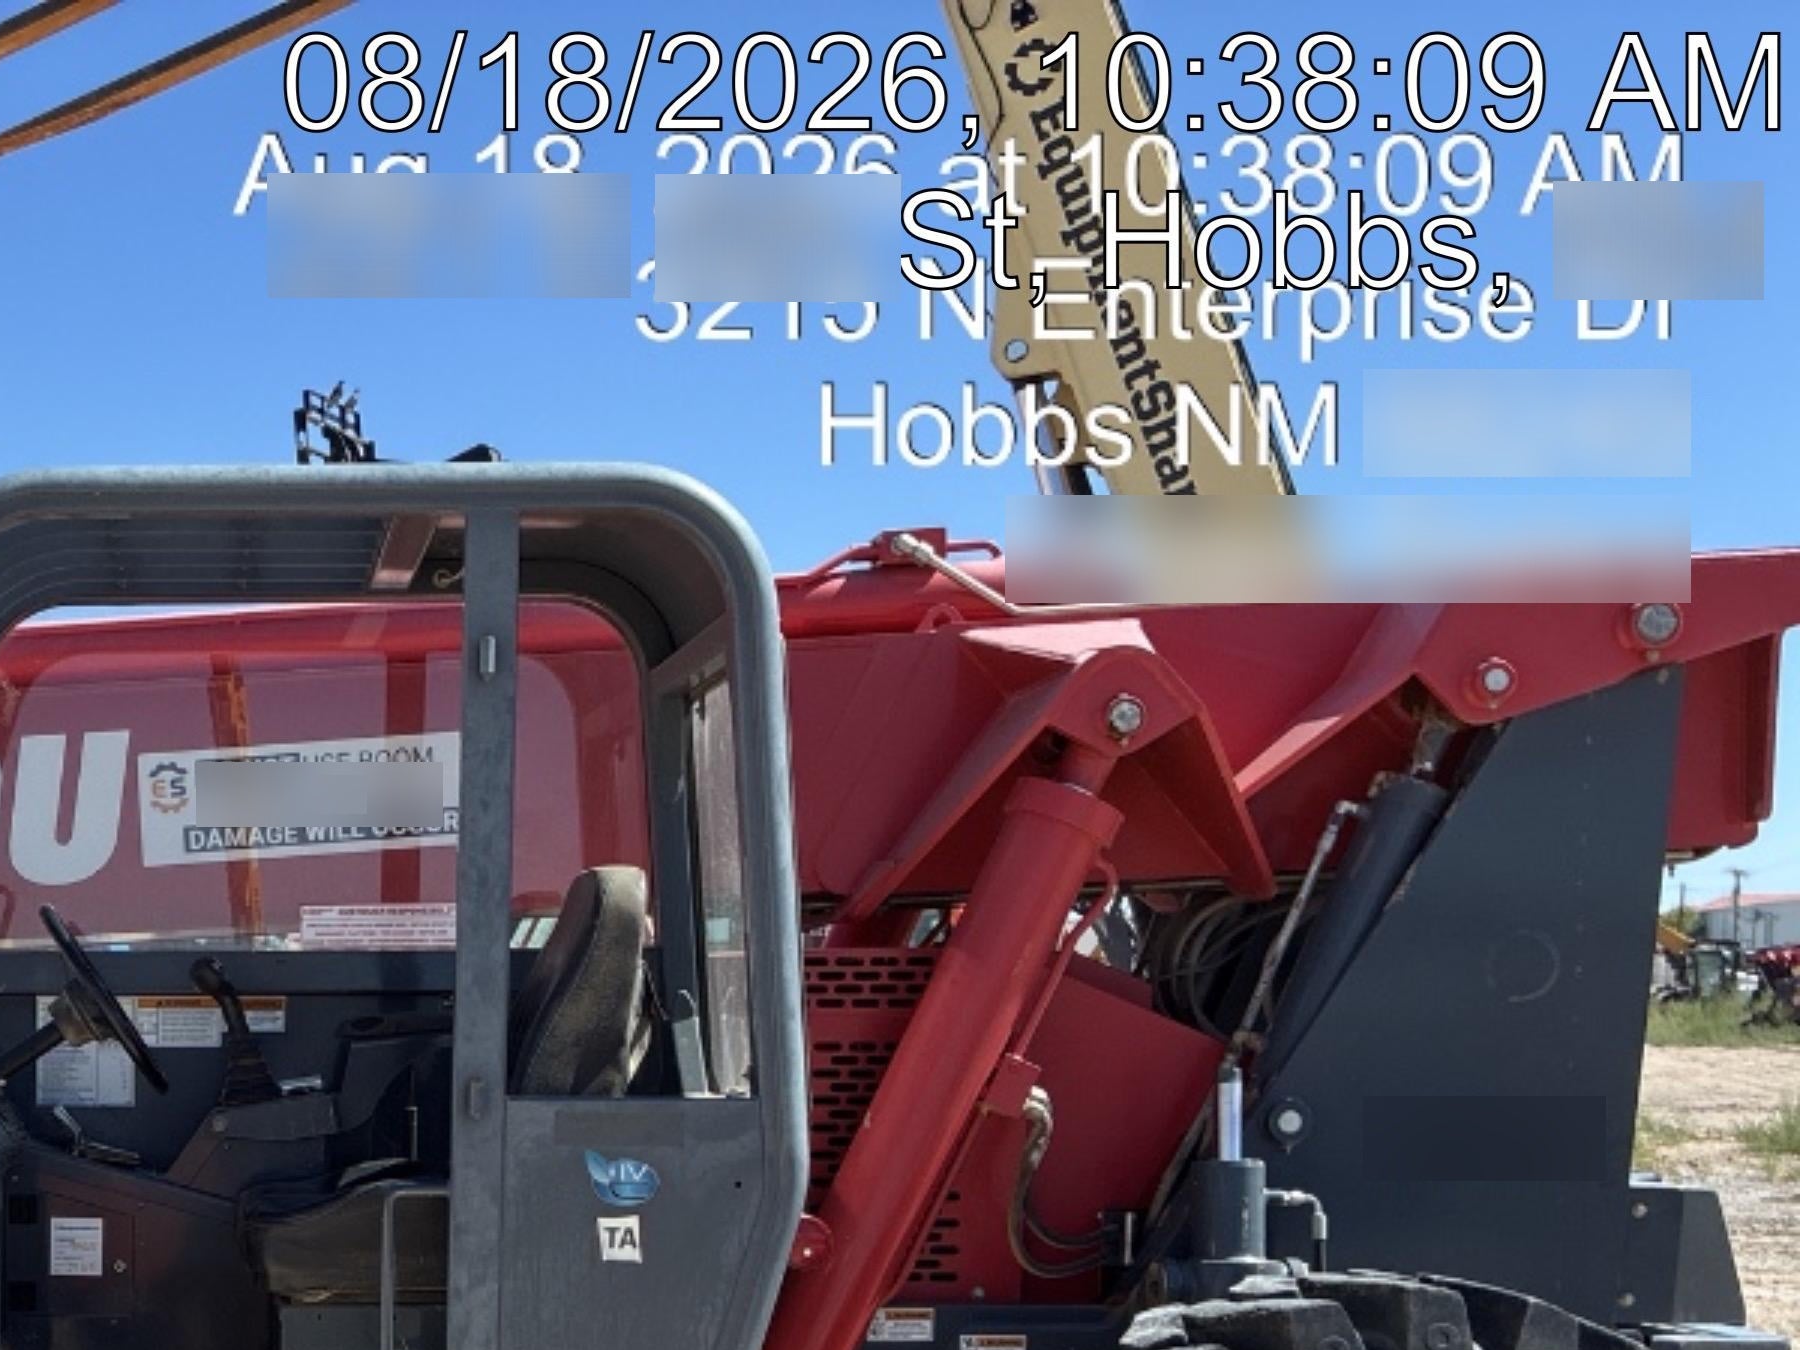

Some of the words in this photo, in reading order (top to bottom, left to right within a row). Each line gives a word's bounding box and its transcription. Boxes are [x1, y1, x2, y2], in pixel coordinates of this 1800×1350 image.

[152, 778, 188, 799] ES
[188, 827, 299, 850] DAMAGE
[602, 1226, 638, 1250] TA
